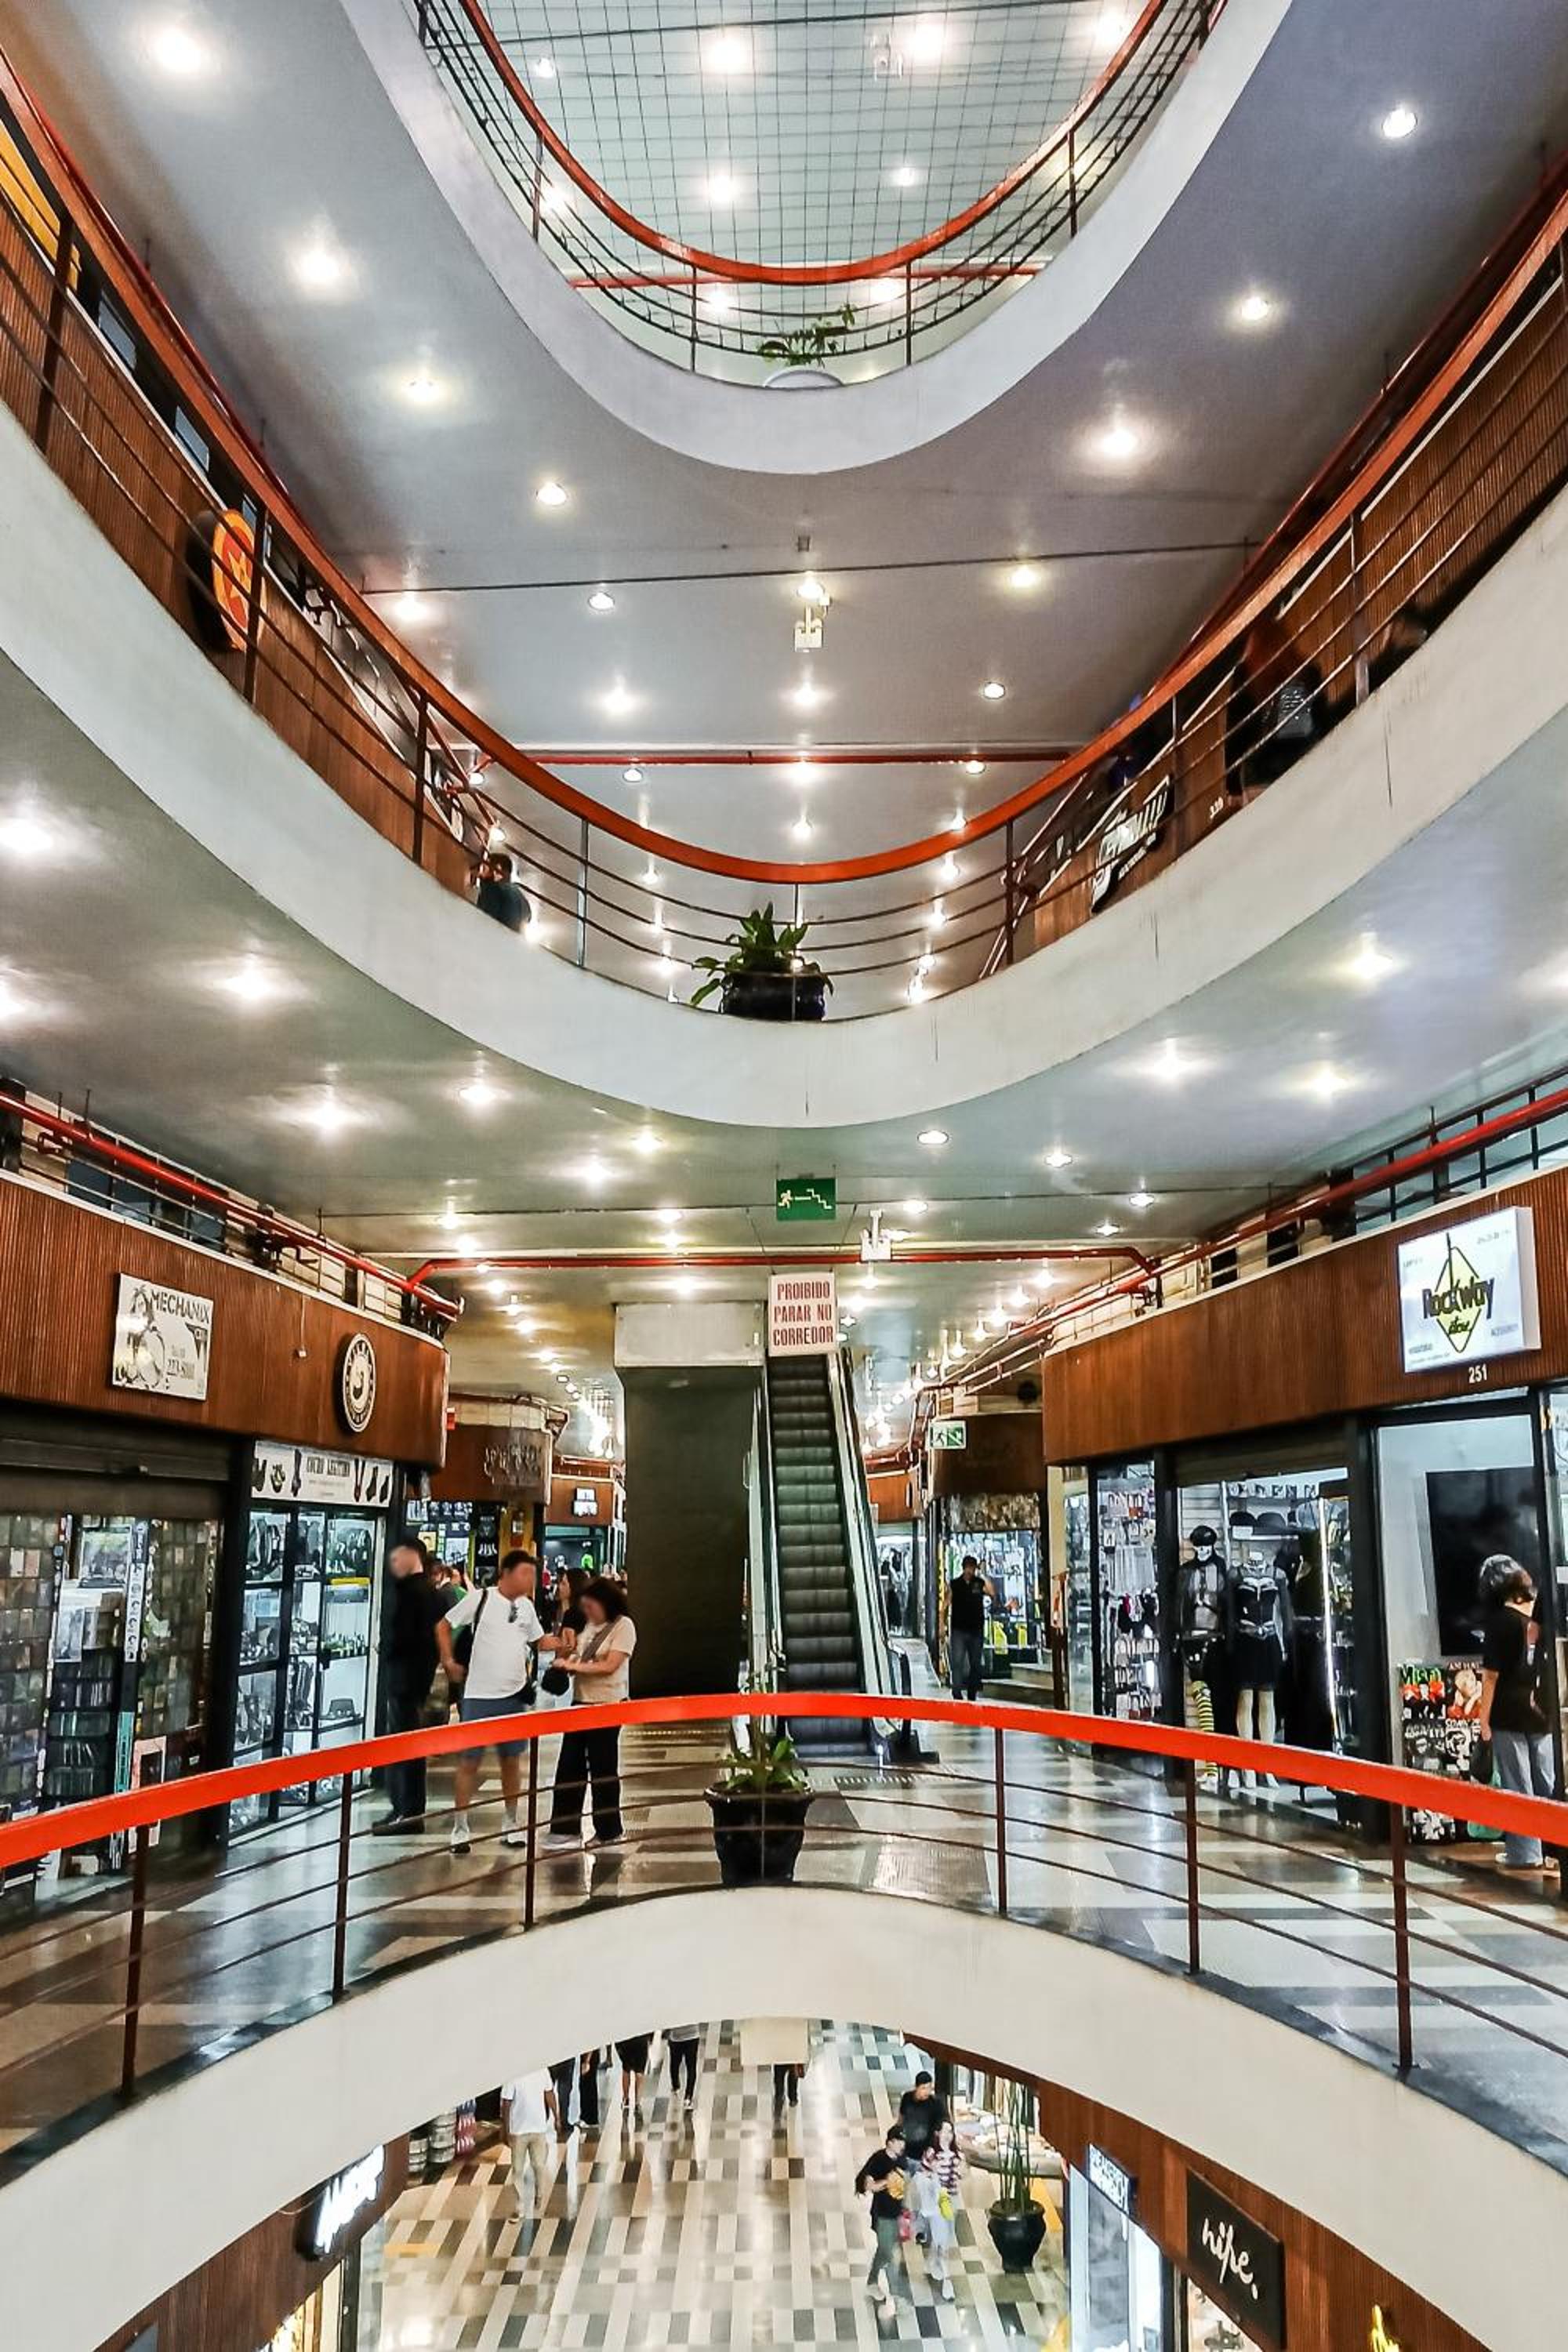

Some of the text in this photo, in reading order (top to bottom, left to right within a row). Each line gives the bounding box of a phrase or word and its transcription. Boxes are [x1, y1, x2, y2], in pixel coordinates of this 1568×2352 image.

[777, 1281, 830, 1301] PROIBIDO
[151, 1288, 209, 1325] MECHANIX
[774, 1304, 832, 1323] PARAR NO
[773, 1326, 833, 1347] CORREDOR
[1468, 1363, 1488, 1384] 251
